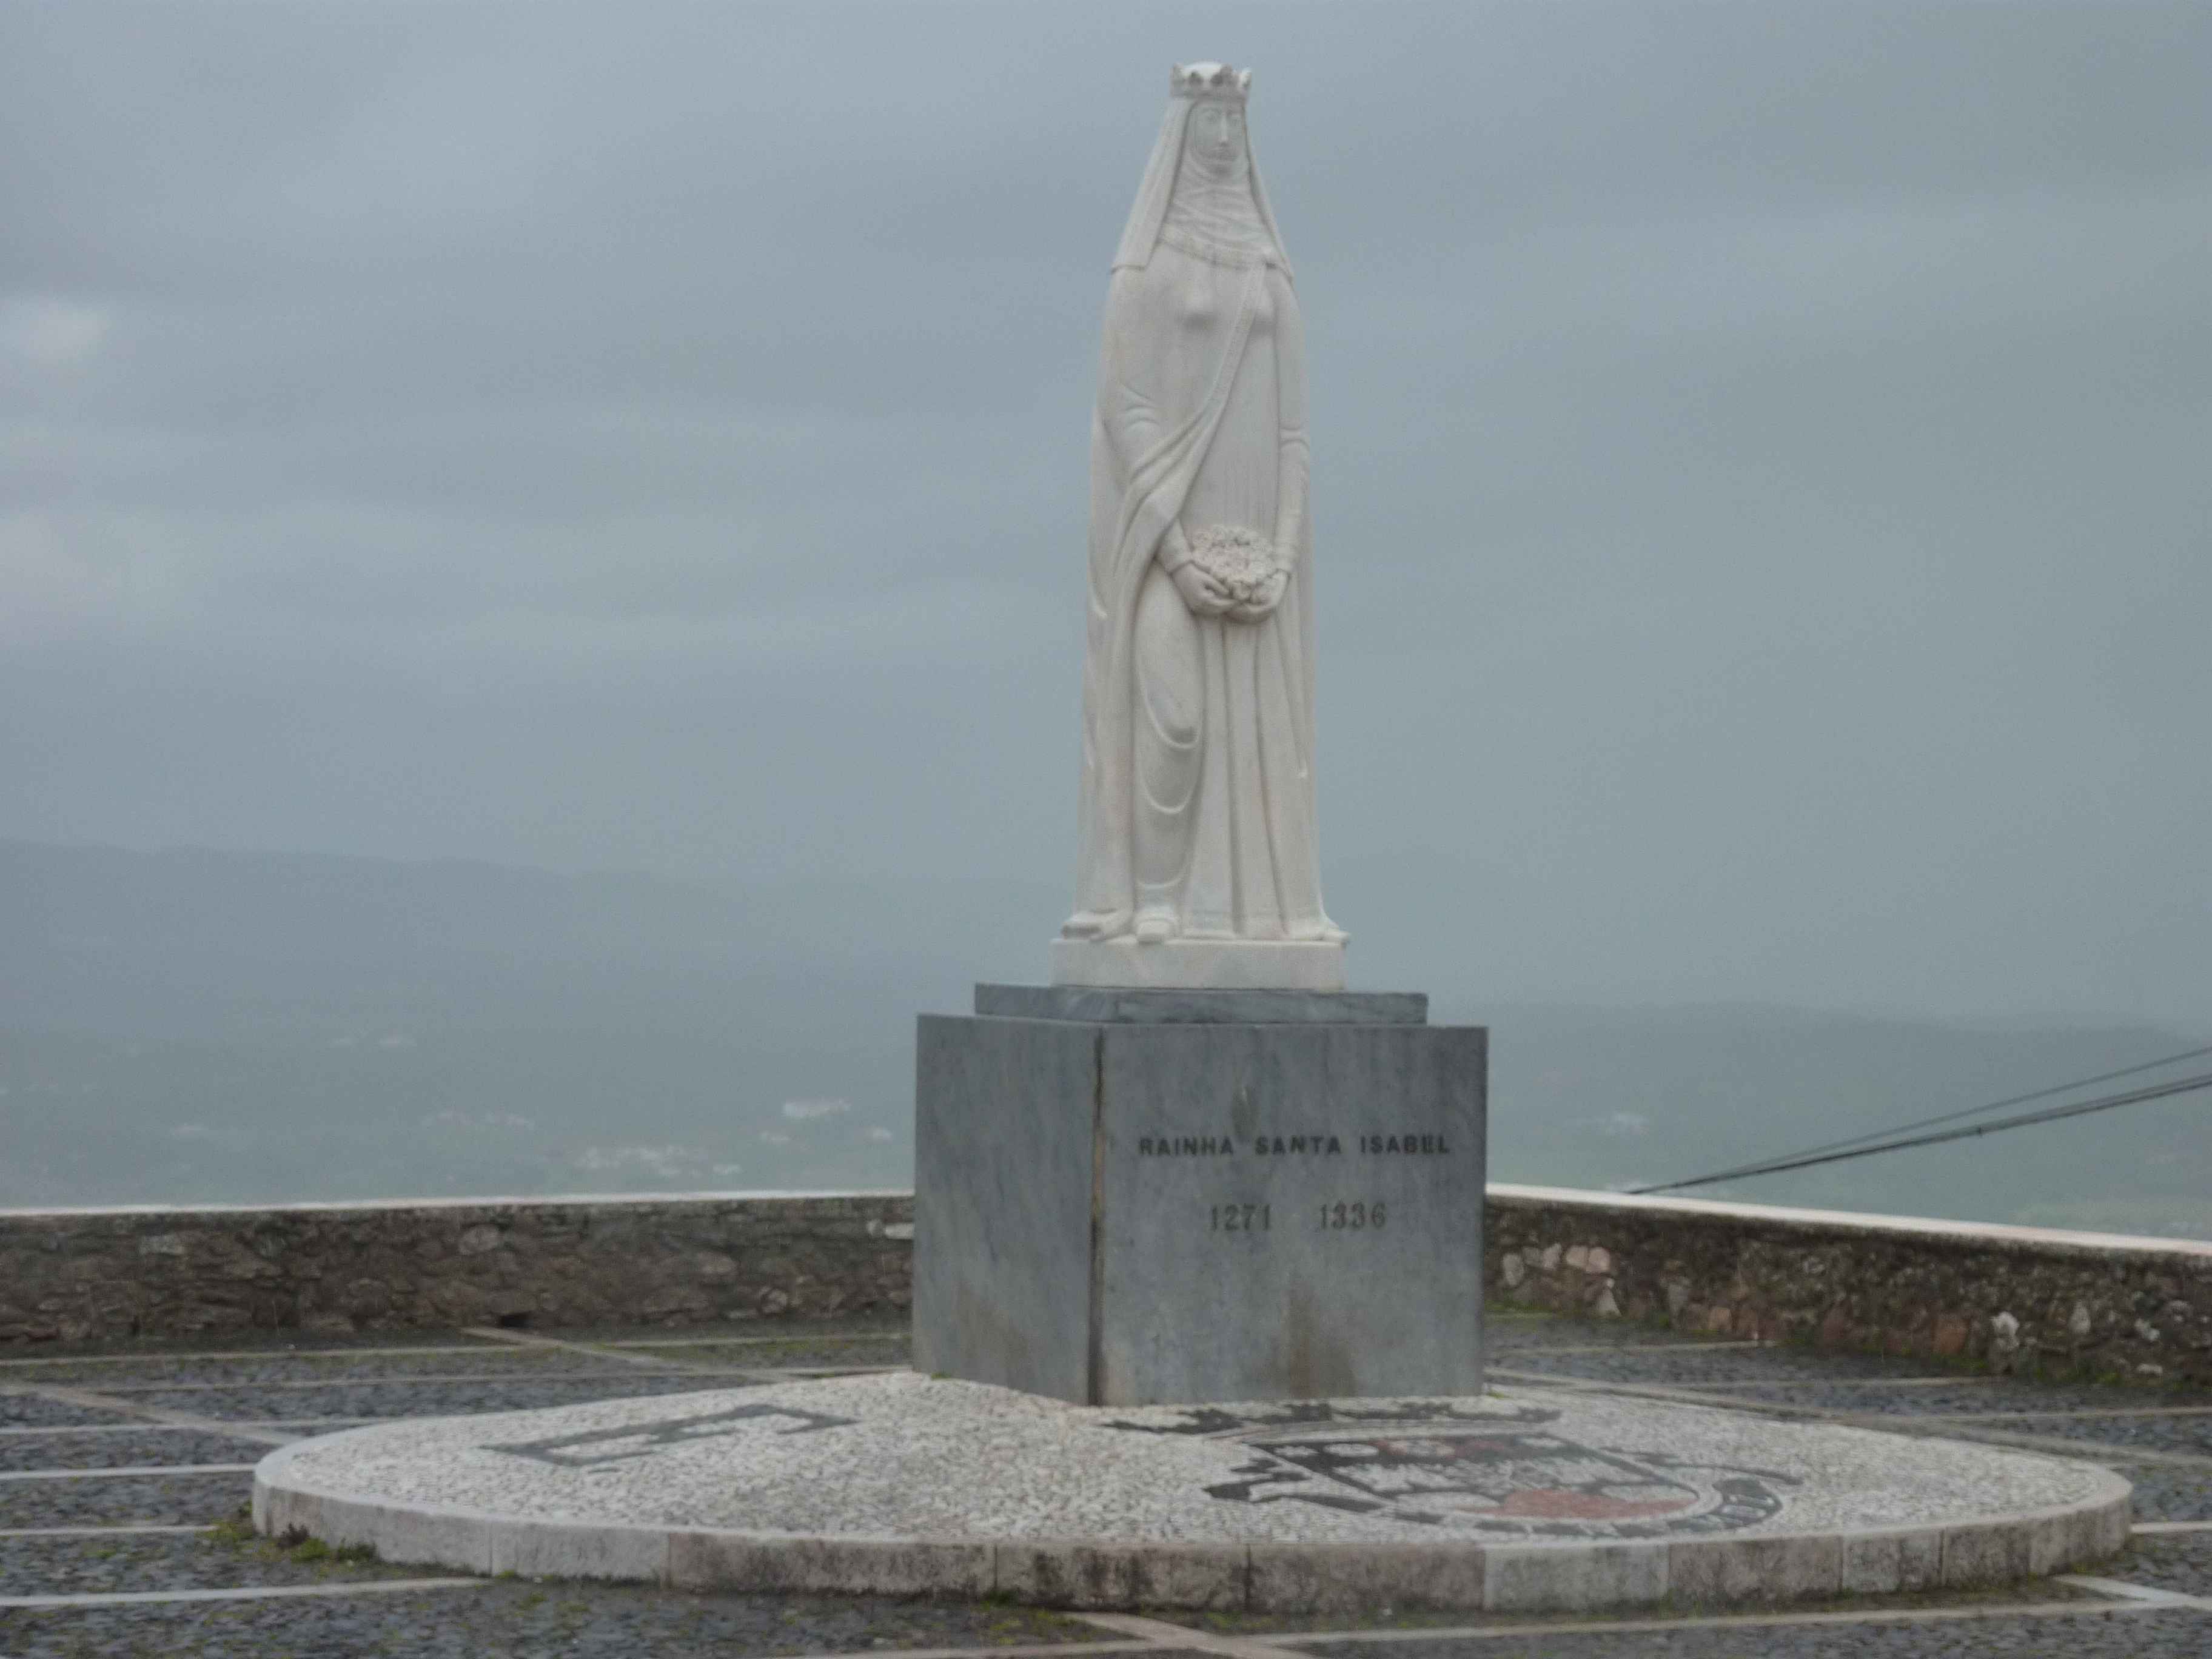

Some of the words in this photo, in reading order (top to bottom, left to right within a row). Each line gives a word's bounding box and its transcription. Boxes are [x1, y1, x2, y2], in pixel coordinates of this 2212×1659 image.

[1139, 1136, 1235, 1157] RAINHA
[1256, 1134, 1342, 1156] SANTA
[1360, 1133, 1450, 1155] ISABEL
[1211, 1202, 1270, 1232] 1271
[1321, 1201, 1387, 1230] 1336
